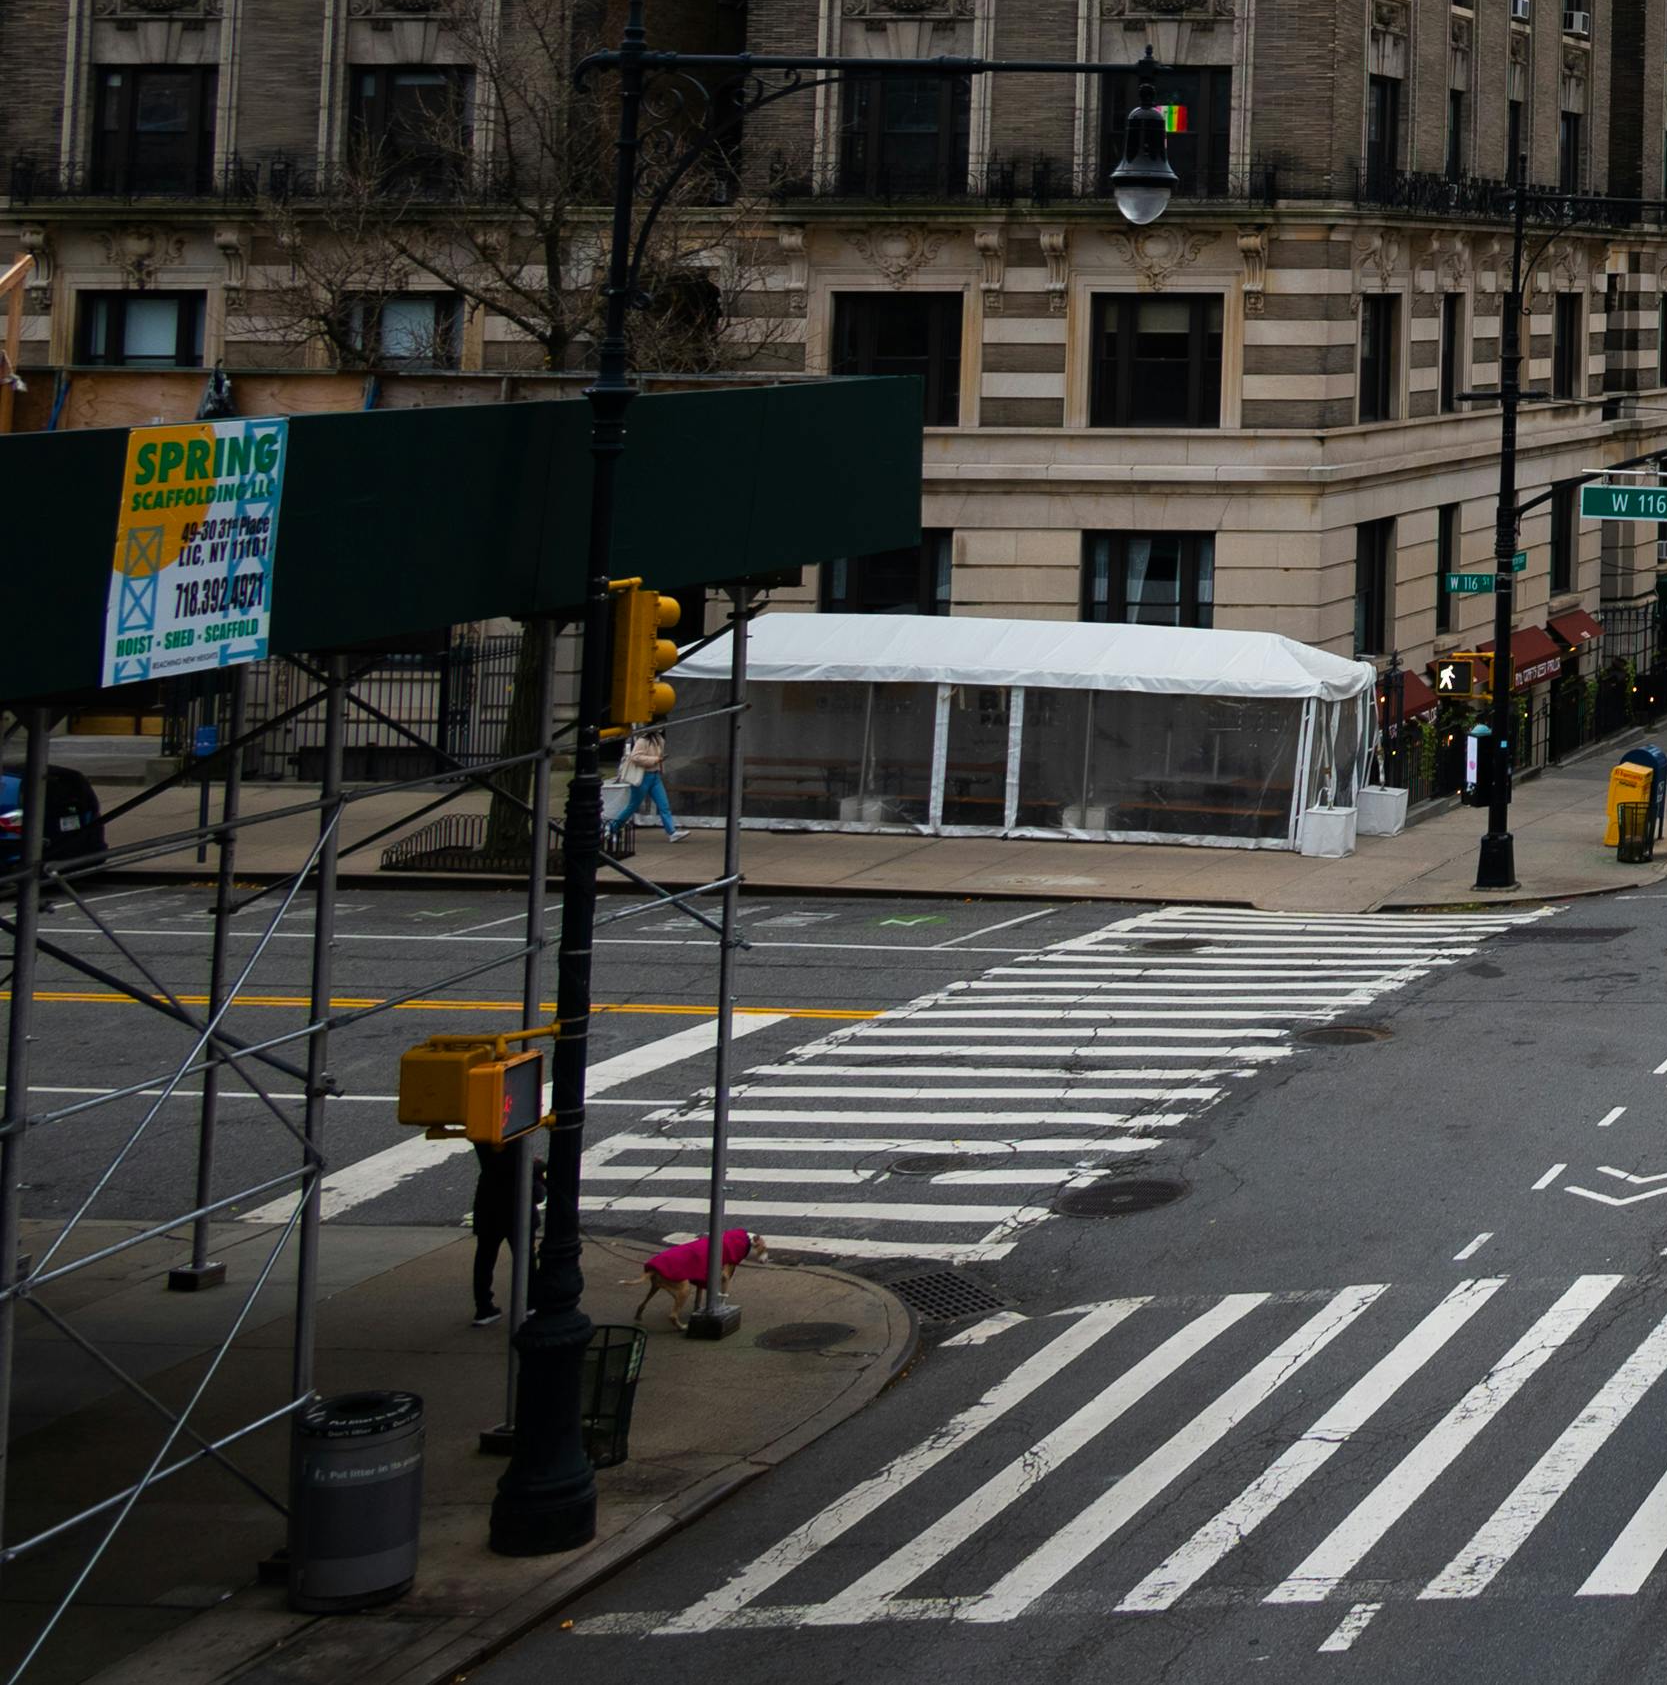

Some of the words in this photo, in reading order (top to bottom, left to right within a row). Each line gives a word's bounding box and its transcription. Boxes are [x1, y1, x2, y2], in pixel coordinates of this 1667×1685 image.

[135, 433, 279, 486] SPRING
[131, 481, 248, 512] SCAFFOLDING
[250, 478, 276, 498] LLC
[1612, 493, 1628, 513] W
[1638, 494, 1666, 514] 116
[181, 517, 215, 543] 49-30
[238, 515, 270, 537] Place
[178, 546, 204, 567] LIC,
[209, 541, 228, 563] NY
[231, 536, 268, 560] 11101
[174, 572, 264, 619] 718.392.4921
[1451, 577, 1458, 590] W
[1464, 577, 1478, 590] 116
[1482, 576, 1490, 586] St
[116, 635, 154, 658] HOIST
[164, 628, 195, 650] SHED
[204, 618, 259, 643] SCAFFOLD
[329, 1470, 348, 1480] Put
[349, 1467, 375, 1478] litter
